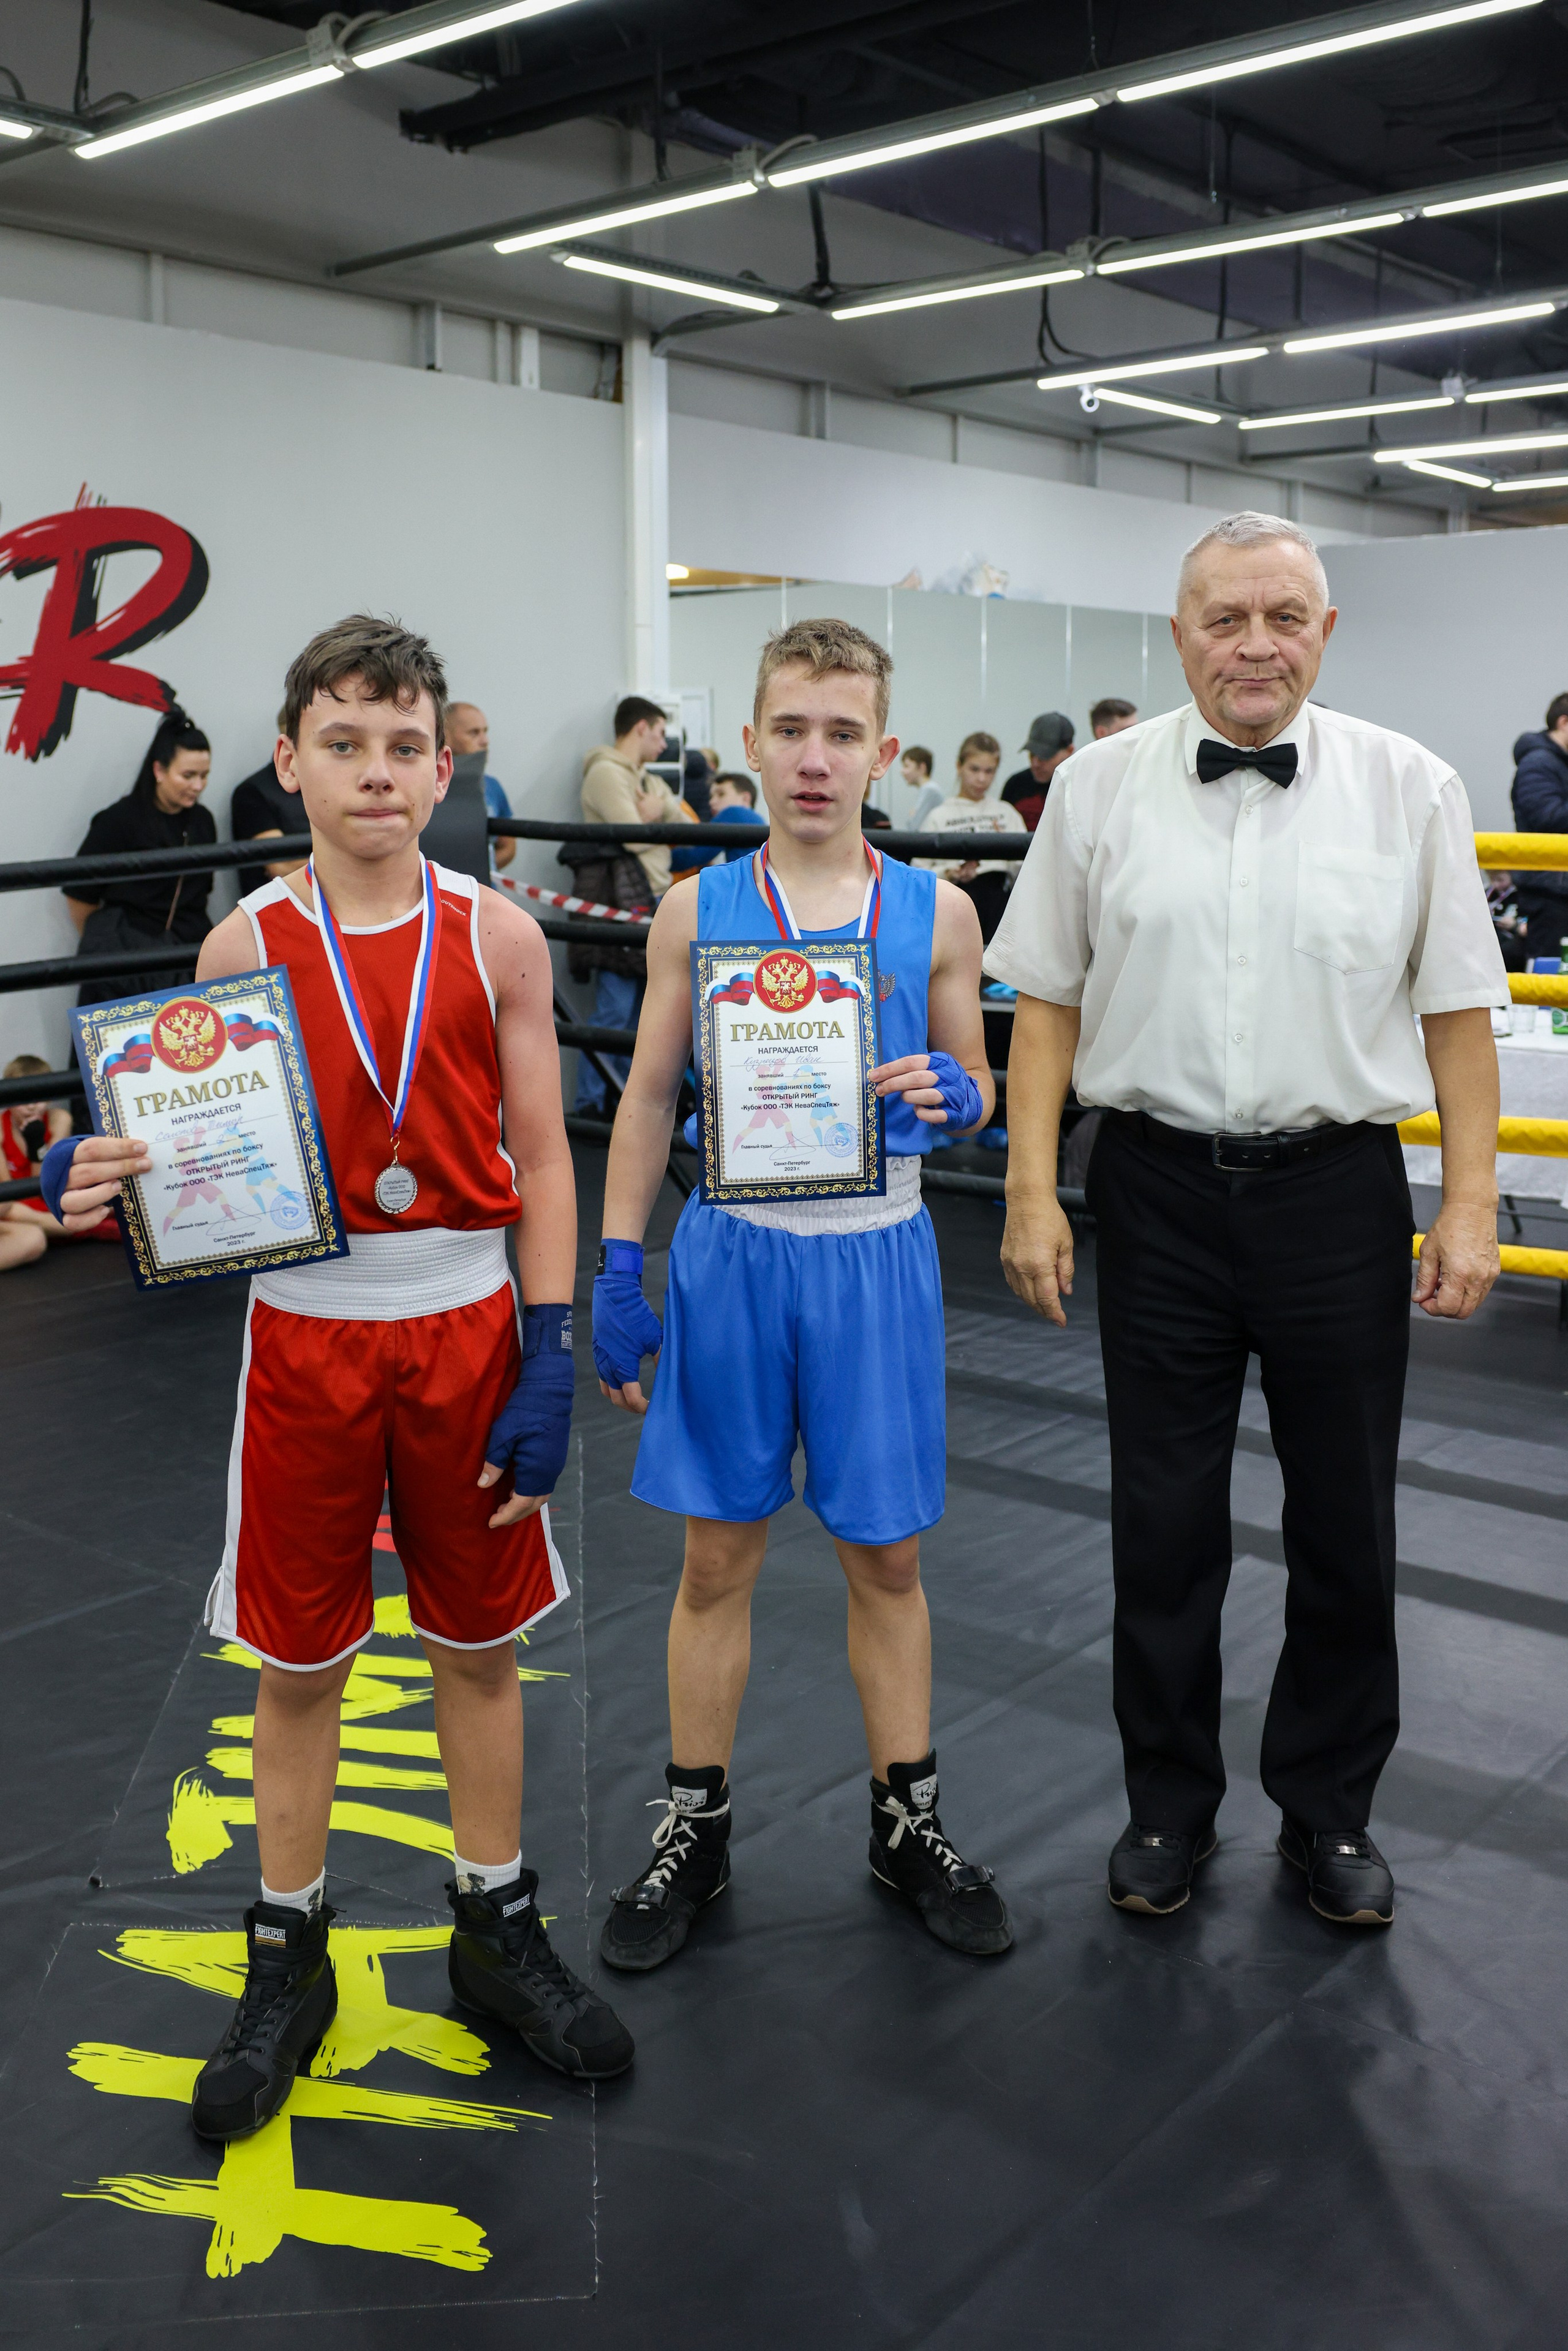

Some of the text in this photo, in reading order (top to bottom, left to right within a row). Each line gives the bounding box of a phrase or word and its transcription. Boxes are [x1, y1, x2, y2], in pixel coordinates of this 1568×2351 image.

[0, 481, 209, 762] R
[730, 1021, 845, 1041] ГРАМОТА
[758, 1046, 818, 1054] НАГРАЖДАЕТСЯ
[796, 1054, 823, 1063] Иван
[133, 1070, 270, 1117] ГРАМОТА
[171, 1103, 241, 1125] НАГРАЖДАЕТСЯ
[175, 1150, 231, 1169] соревнованиях
[243, 1142, 263, 1153] боксу
[176, 1142, 207, 1153] занявший
[186, 1156, 250, 1176] ОТКРЫТЫЙ РИНГ
[189, 1177, 205, 1186] ООО
[213, 1231, 255, 1243] Санкт-Петербург
[503, 1896, 530, 1915] FIGHTEXPERT
[255, 1926, 286, 1939] FIGHTEXPERT
